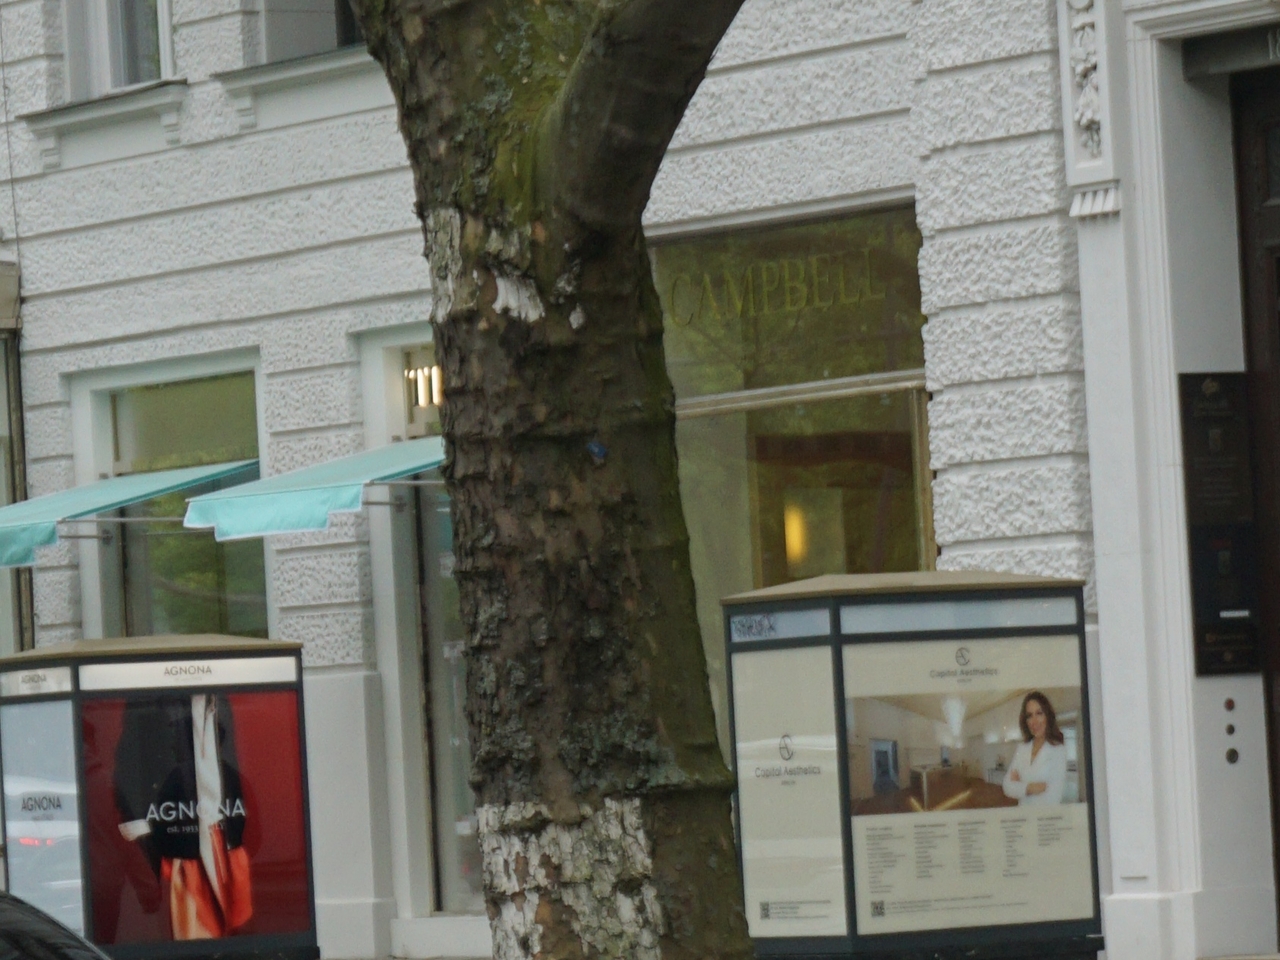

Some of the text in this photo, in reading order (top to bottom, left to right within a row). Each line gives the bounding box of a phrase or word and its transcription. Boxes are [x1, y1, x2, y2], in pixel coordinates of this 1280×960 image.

[669, 248, 886, 327] CAMPBELL
[164, 665, 213, 676] AGNONA
[21, 796, 62, 812] AGNONA
